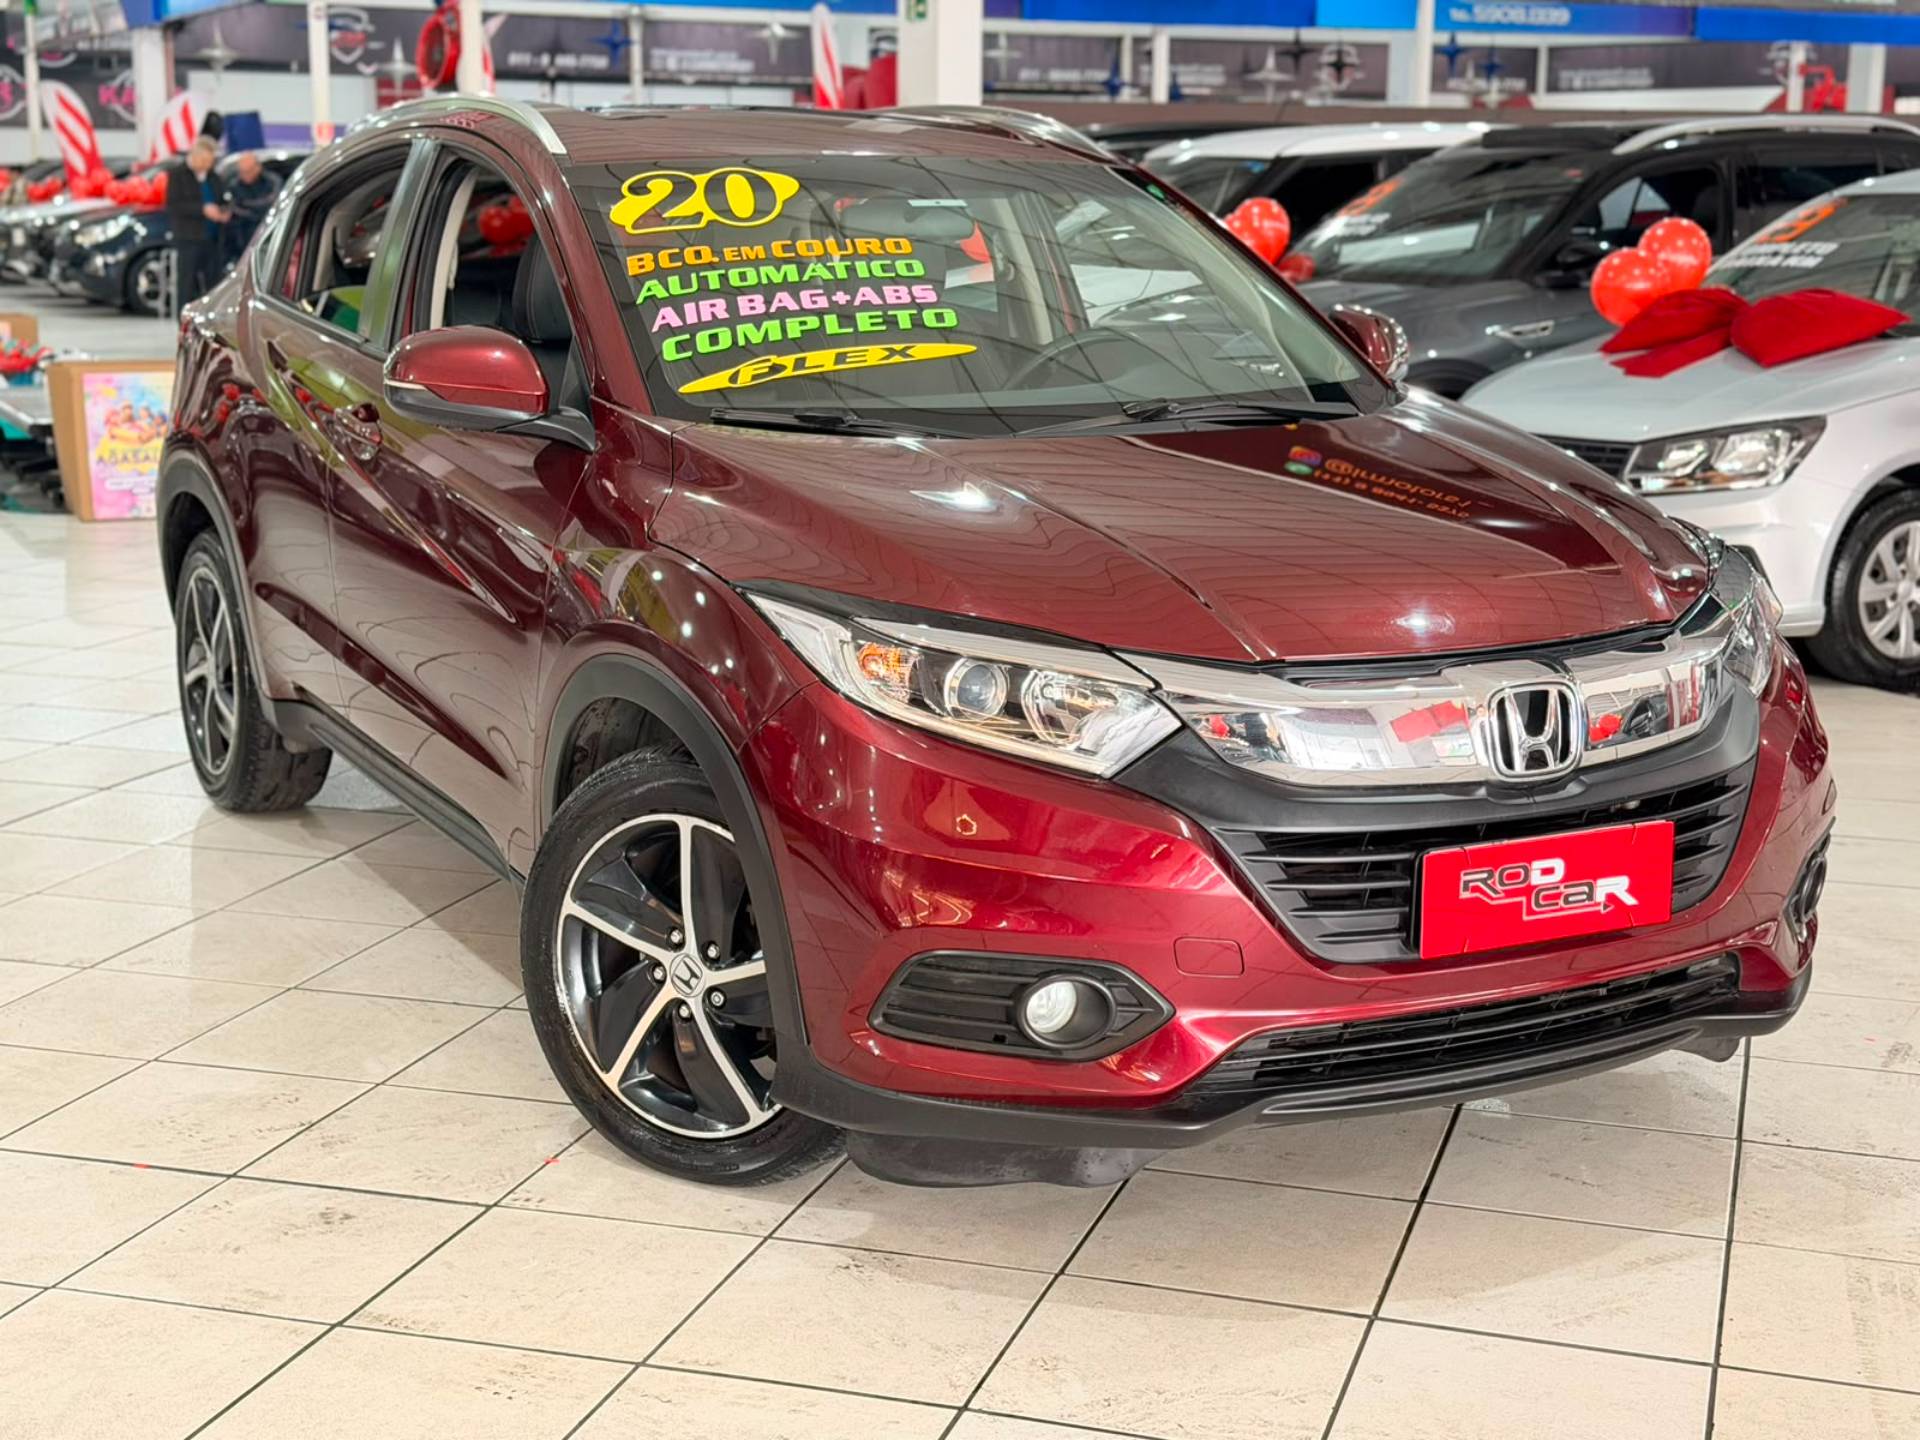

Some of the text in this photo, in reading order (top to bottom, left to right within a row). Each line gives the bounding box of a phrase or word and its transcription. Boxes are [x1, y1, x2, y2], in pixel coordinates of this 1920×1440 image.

[614, 168, 793, 233] 20
[724, 245, 766, 262] EM
[771, 238, 913, 258] COURO
[651, 284, 939, 333] AIR BAG+ABS
[662, 308, 958, 362] COMPLETO
[728, 345, 919, 386] FLEX
